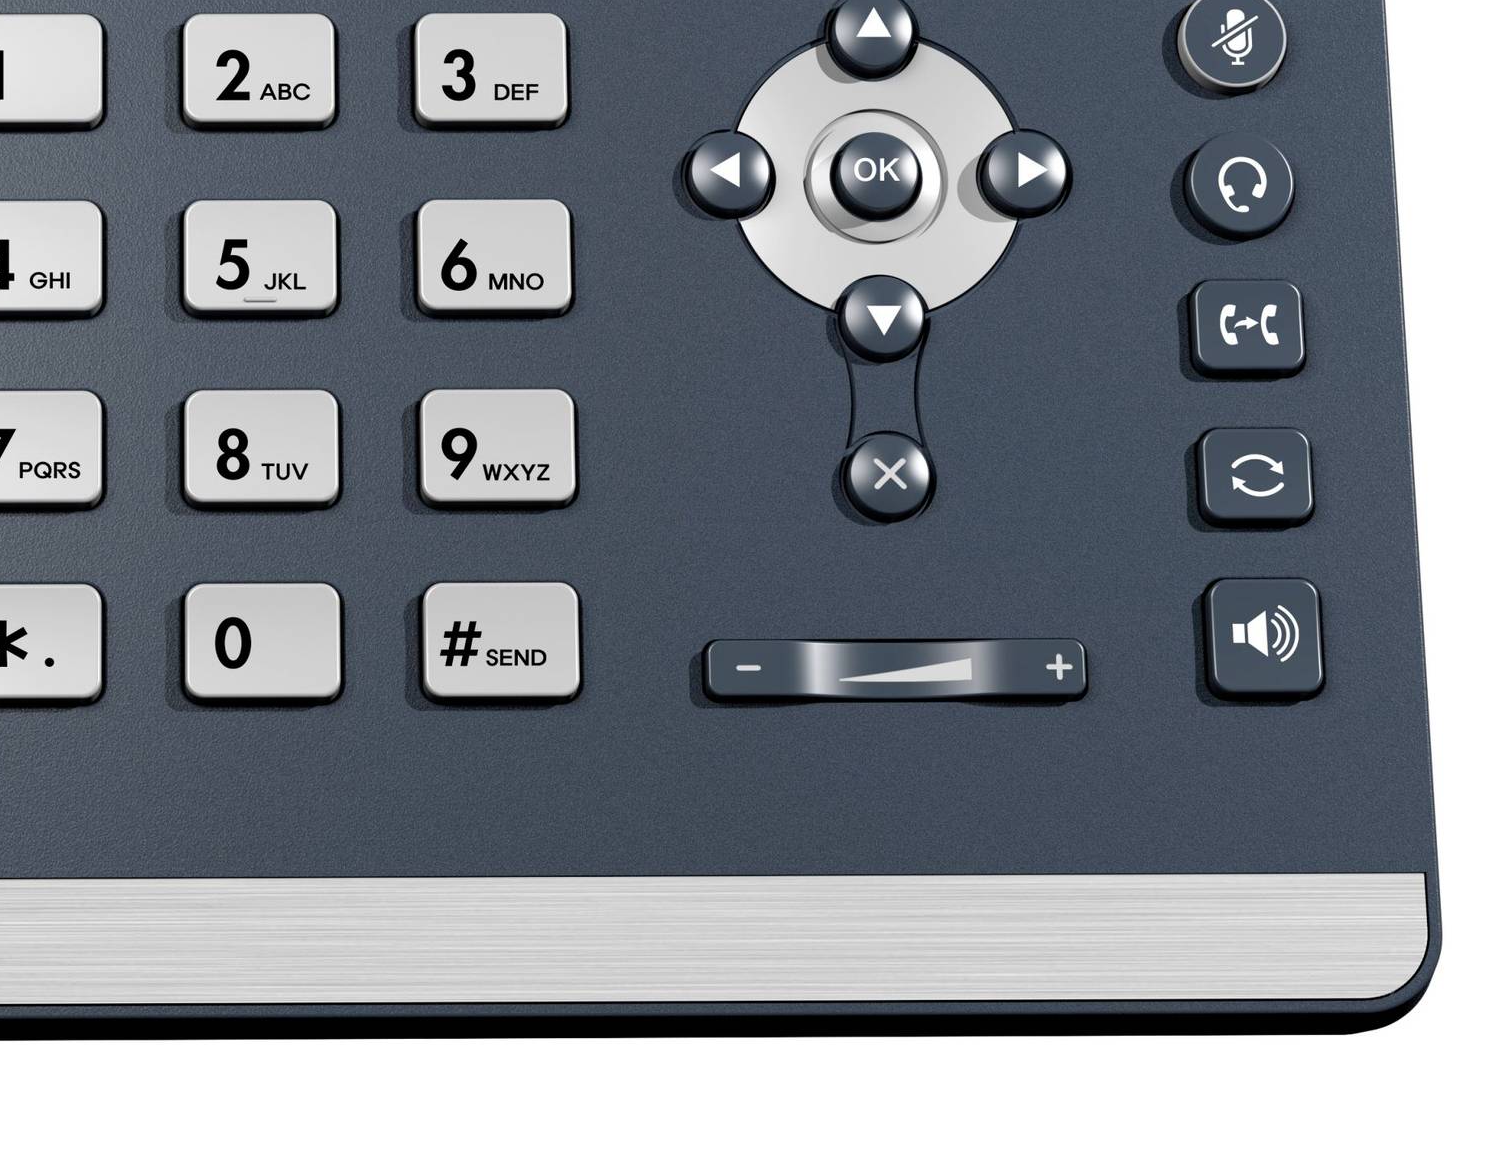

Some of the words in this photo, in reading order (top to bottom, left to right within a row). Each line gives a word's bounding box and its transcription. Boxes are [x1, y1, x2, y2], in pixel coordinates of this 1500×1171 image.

[215, 49, 251, 101] 2
[259, 82, 311, 101] ABC
[441, 48, 477, 102] 3
[494, 83, 540, 101] DEF
[853, 156, 901, 183] OK
[29, 271, 71, 290] GHI
[215, 238, 250, 291] 5
[263, 272, 307, 291] JKL
[440, 238, 478, 292] 6
[488, 272, 545, 291] MNO
[19, 461, 81, 480] PQRS
[216, 427, 251, 481] 8
[260, 462, 309, 481] TUV
[440, 427, 478, 481] 9
[482, 463, 551, 482] WXYZ
[214, 616, 252, 670] 0
[485, 648, 548, 667] SEND
